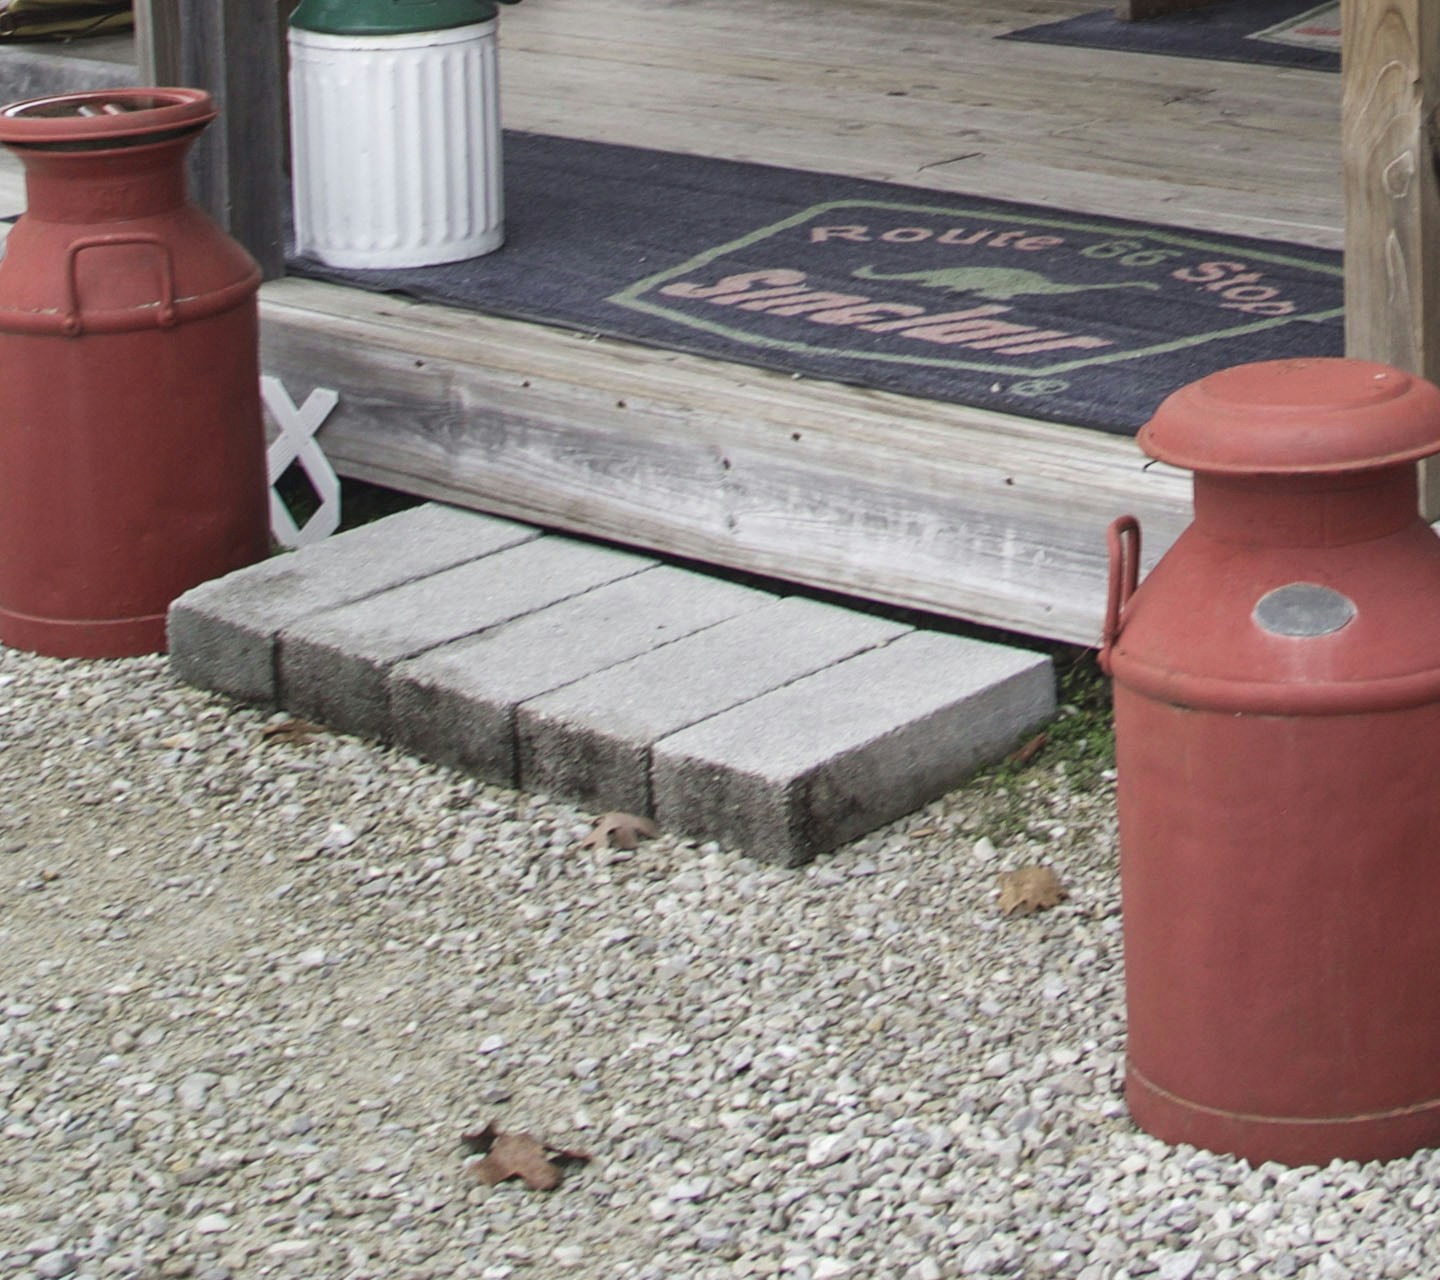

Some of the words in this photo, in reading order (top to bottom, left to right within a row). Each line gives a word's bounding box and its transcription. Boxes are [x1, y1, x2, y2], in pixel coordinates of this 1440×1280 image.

[659, 267, 1115, 357] Sinclair
[1078, 240, 1184, 269] 66
[1172, 261, 1299, 317] Stop
